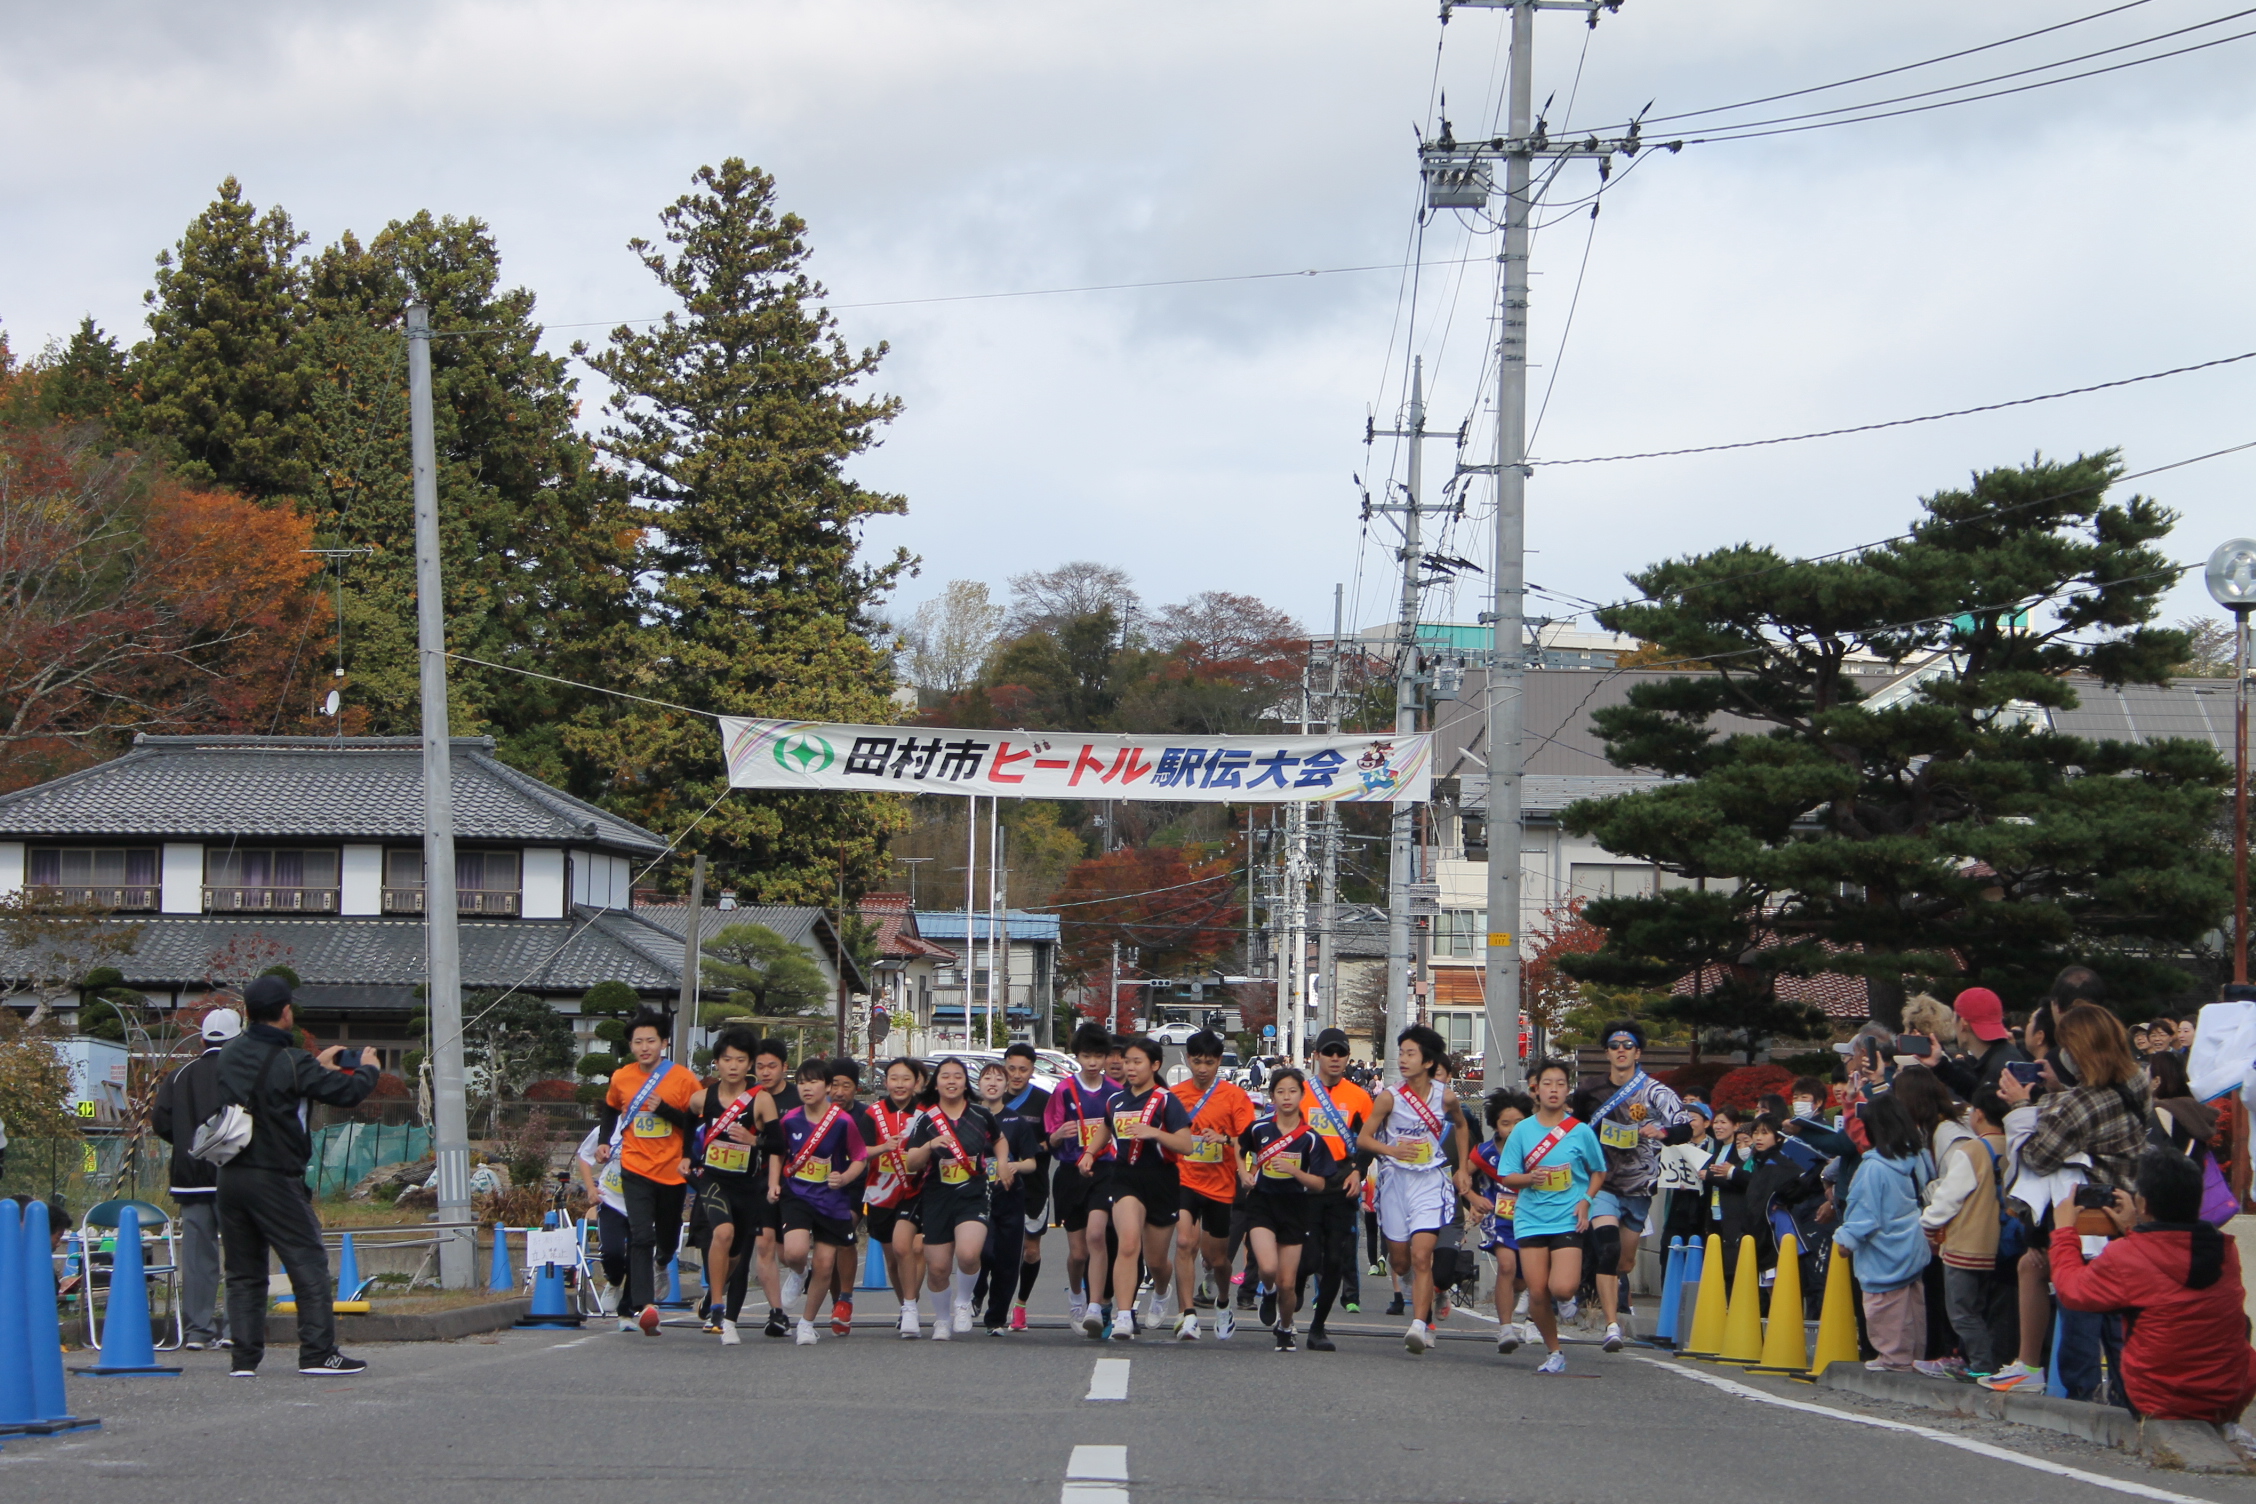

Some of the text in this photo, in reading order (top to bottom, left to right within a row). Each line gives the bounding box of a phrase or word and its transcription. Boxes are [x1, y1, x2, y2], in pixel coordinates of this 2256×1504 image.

[842, 737, 1348, 790] 田村市ビートル駅伝大会
[1310, 1114, 1329, 1129] 43
[1603, 1126, 1635, 1142] 41-1
[709, 1146, 745, 1164] 31-1
[1194, 1143, 1219, 1157] 4-1
